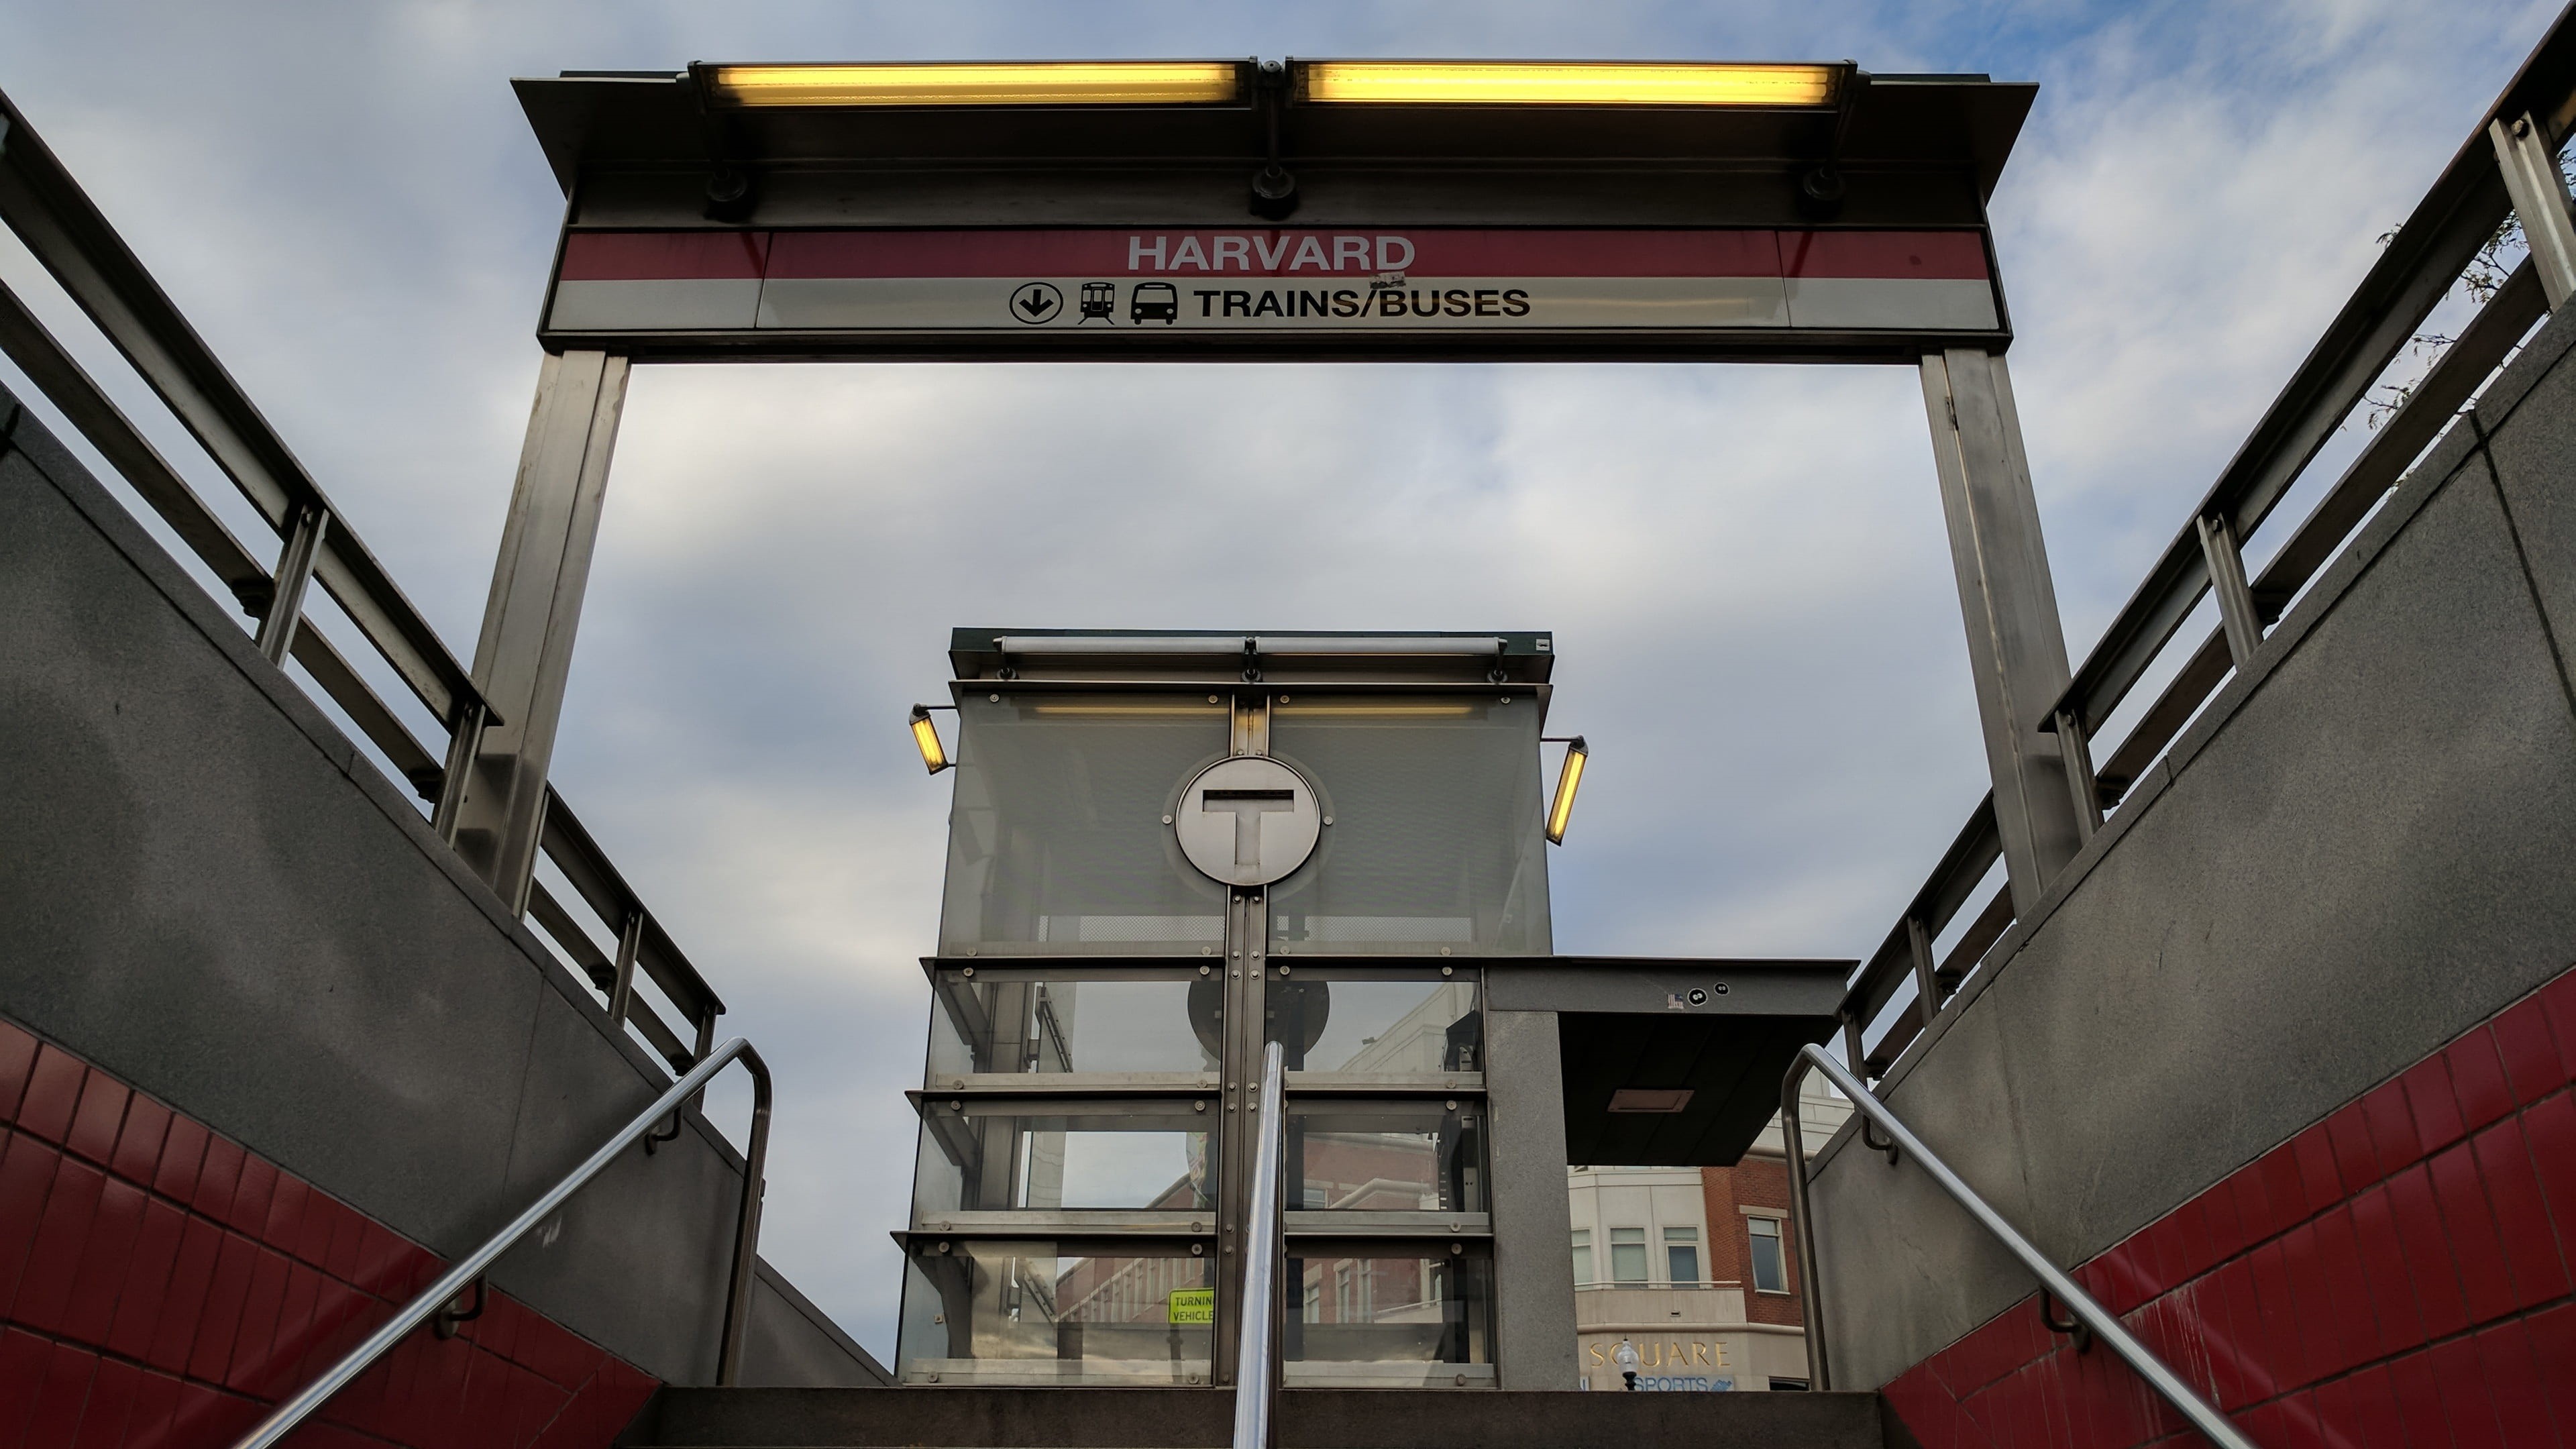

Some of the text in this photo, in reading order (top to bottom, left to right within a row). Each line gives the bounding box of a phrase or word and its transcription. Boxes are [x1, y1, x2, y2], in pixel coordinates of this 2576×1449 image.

[1128, 235, 1415, 270] HARVARD
[1193, 289, 1531, 317] TRAINS/BUSES
[1203, 790, 1294, 865] T
[1175, 1296, 1214, 1307] TURNIN
[1633, 1377, 1708, 1391] SPORTS
